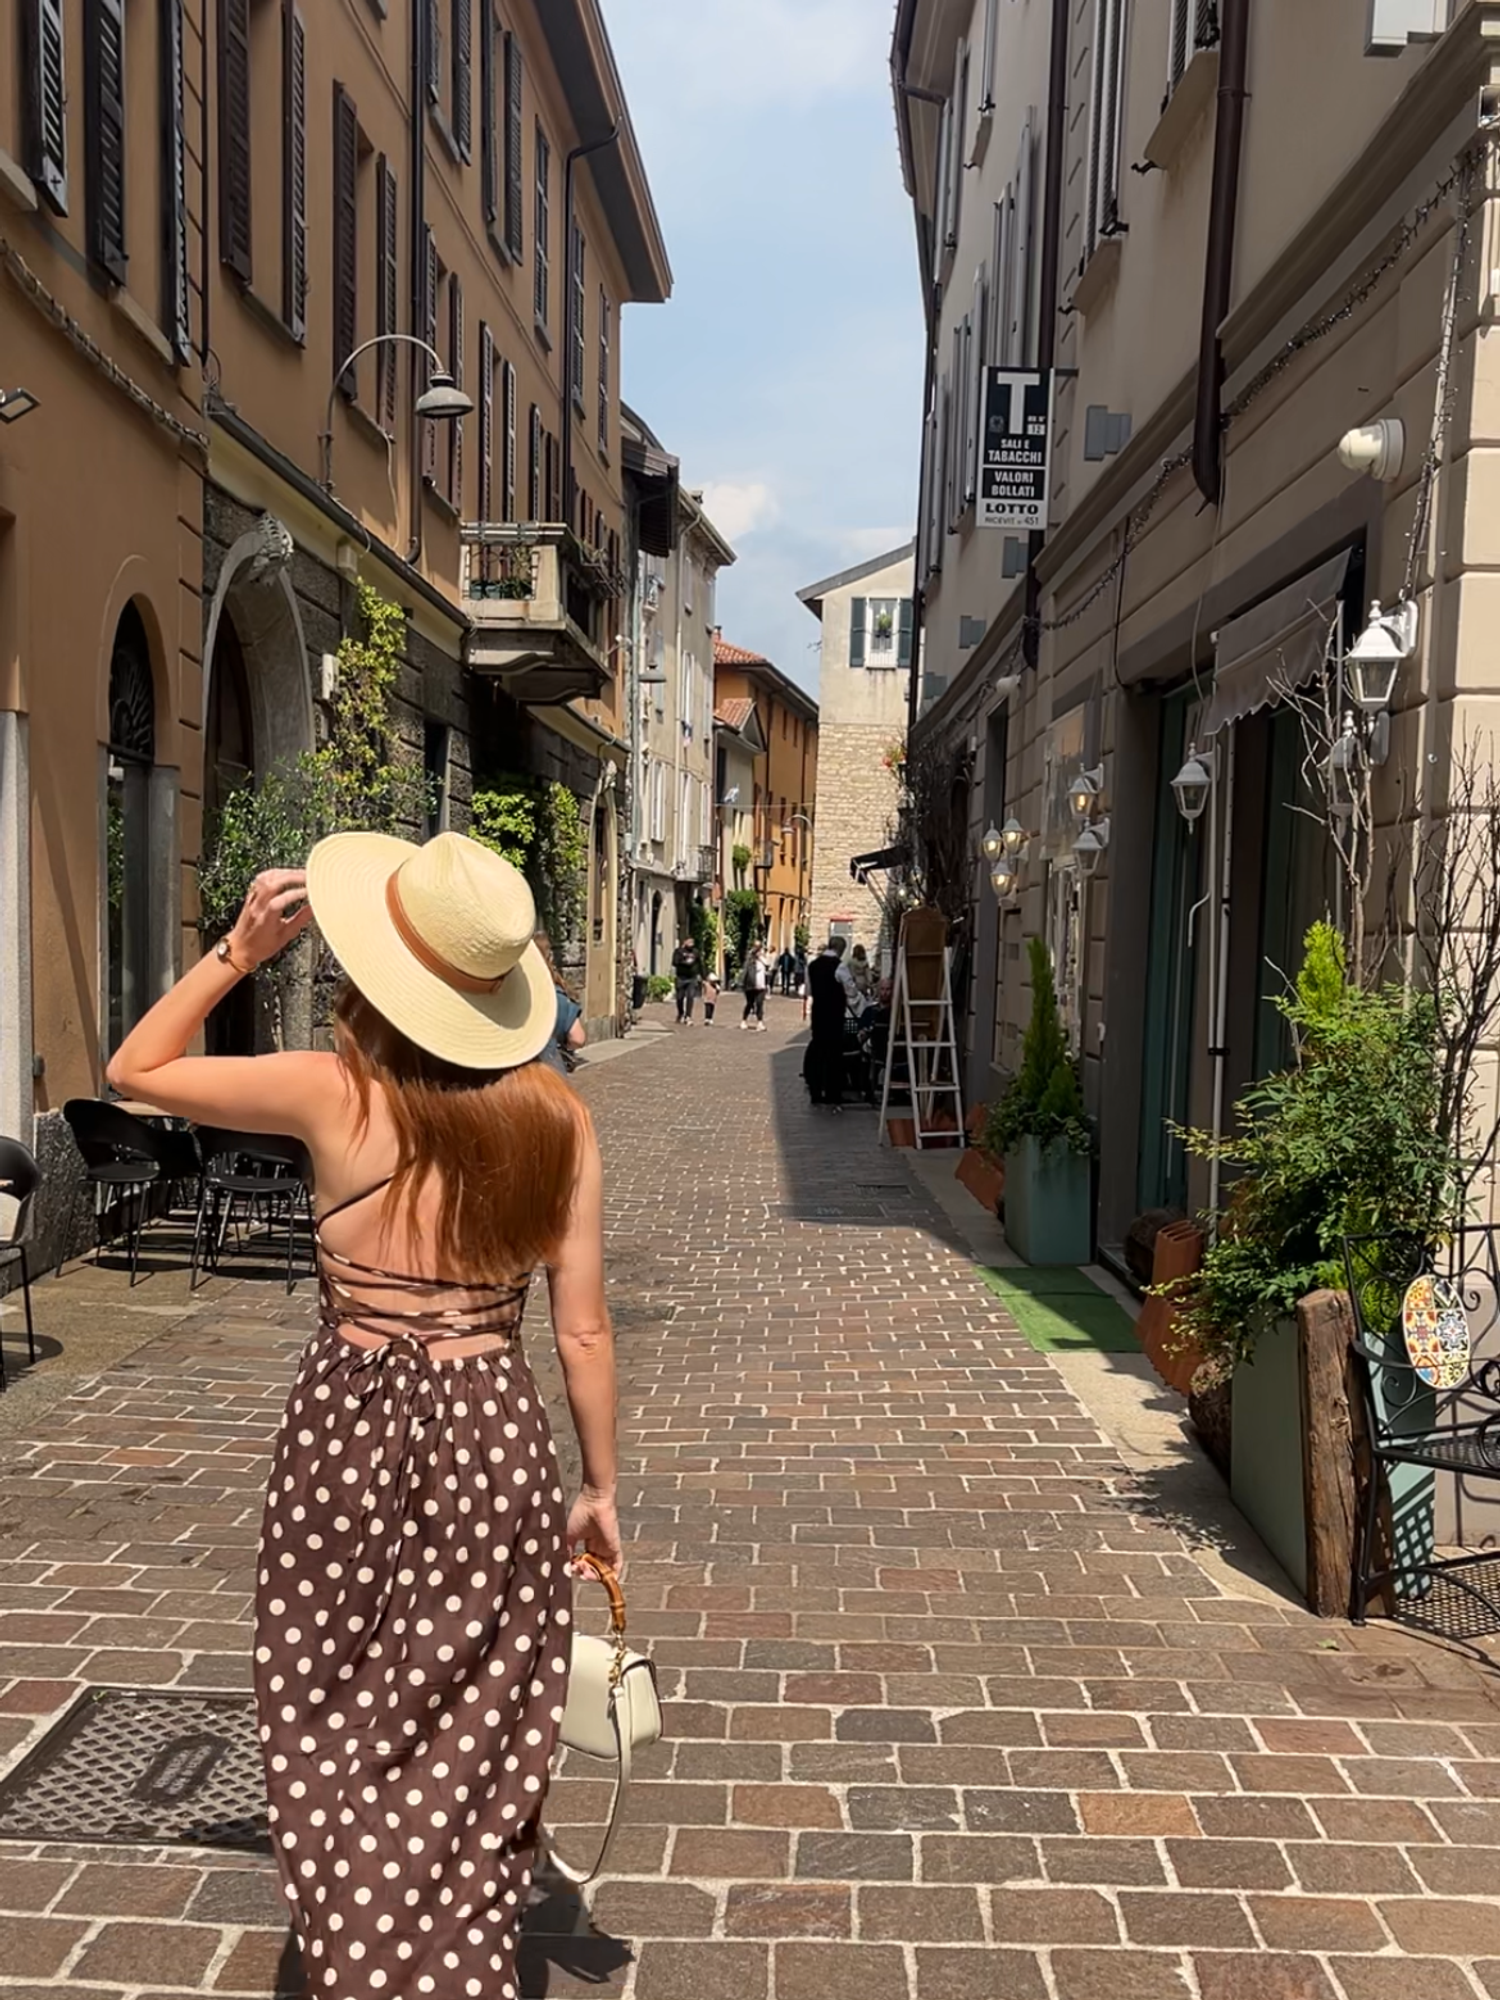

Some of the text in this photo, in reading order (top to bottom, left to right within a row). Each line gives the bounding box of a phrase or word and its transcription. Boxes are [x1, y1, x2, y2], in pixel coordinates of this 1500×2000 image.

[997, 372, 1040, 435] T
[1001, 439, 1030, 449] SALI E
[988, 450, 1042, 464] TABACCHI
[994, 471, 1034, 484] VALORI
[991, 484, 1035, 498] BOLLATI
[985, 503, 1039, 515] LOTTO
[1024, 516, 1039, 525] 451
